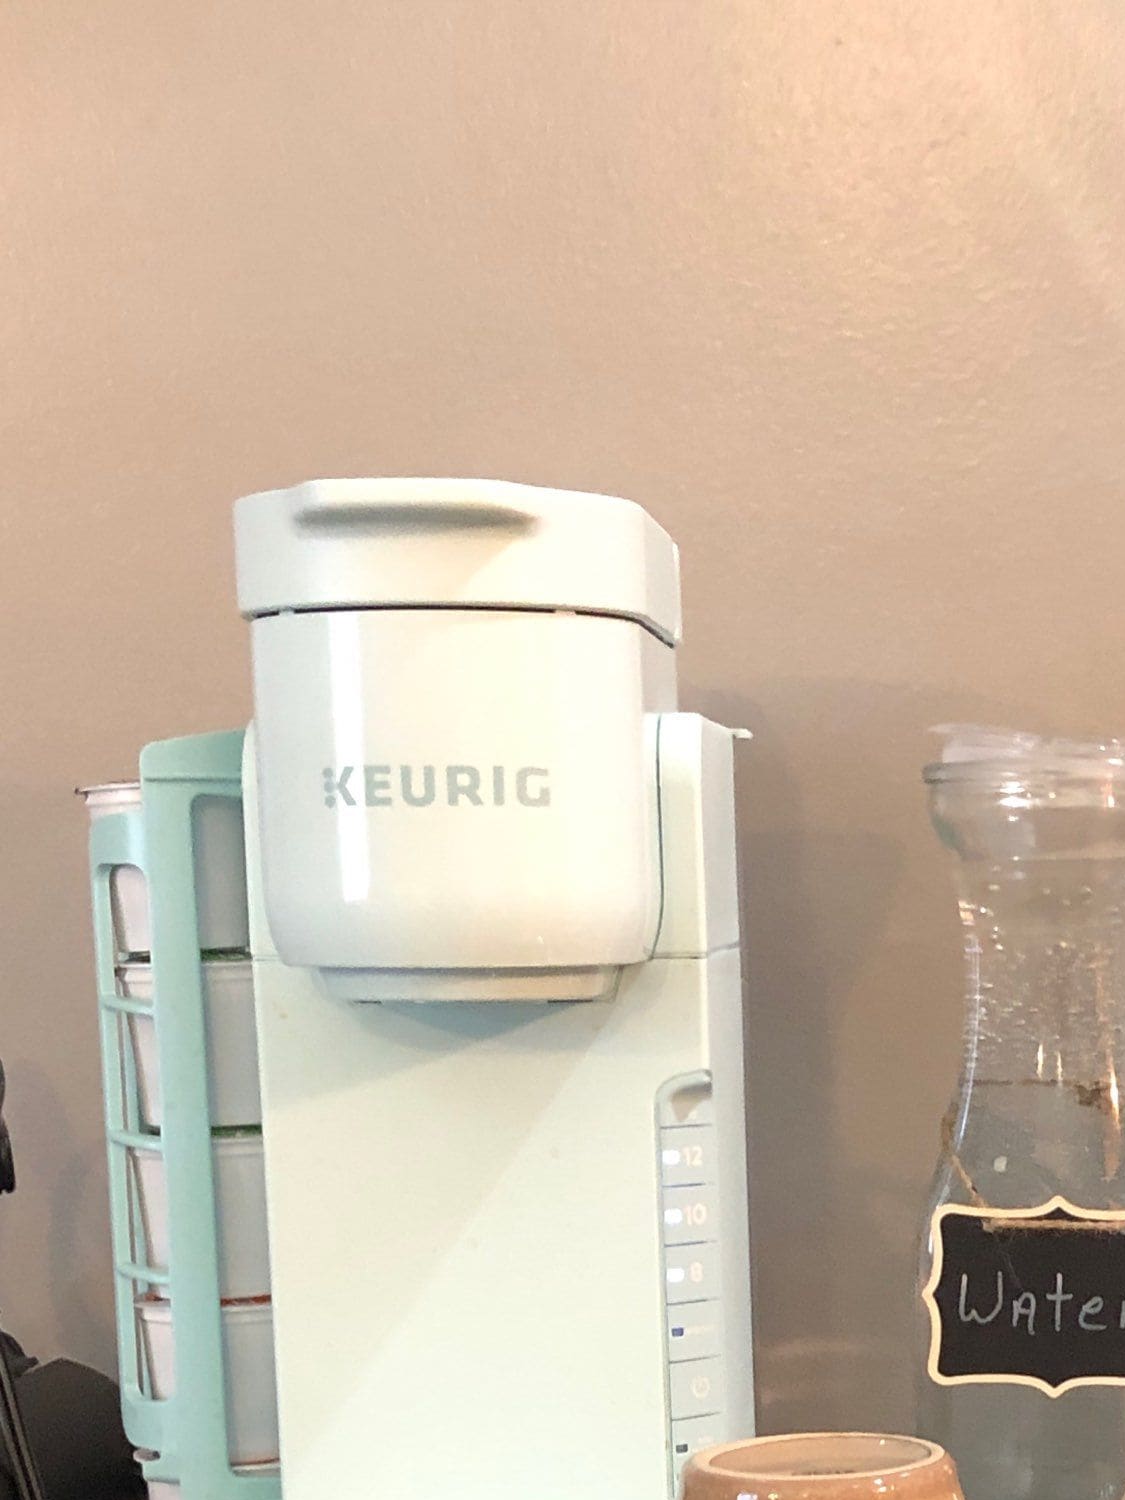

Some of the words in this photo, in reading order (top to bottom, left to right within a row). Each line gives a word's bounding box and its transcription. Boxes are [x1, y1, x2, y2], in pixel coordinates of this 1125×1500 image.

[322, 764, 551, 808] KEURIG
[681, 1145, 703, 1167] 12
[682, 1202, 707, 1227] 10
[689, 1261, 703, 1283] 8
